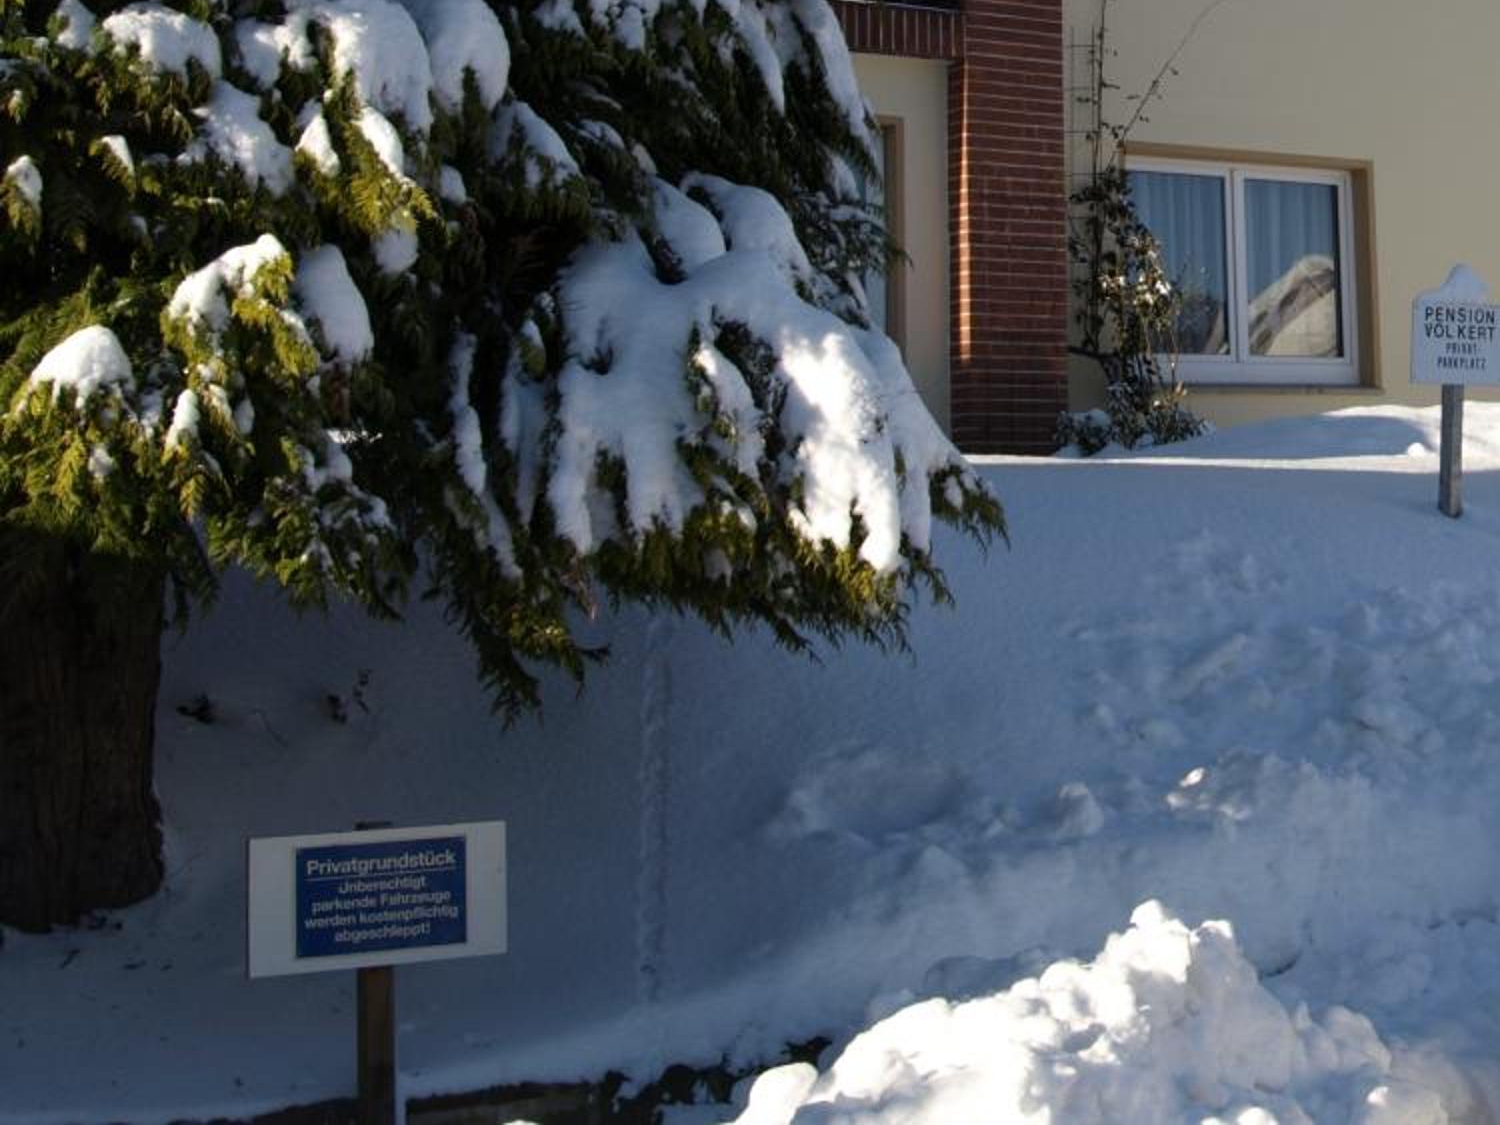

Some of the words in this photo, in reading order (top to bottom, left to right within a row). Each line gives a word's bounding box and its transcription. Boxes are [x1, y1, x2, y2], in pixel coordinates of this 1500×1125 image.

[1425, 306, 1495, 324] PENSION
[306, 849, 456, 876] Privatgrundstück
[311, 894, 376, 915] parkende
[305, 913, 357, 929] werden
